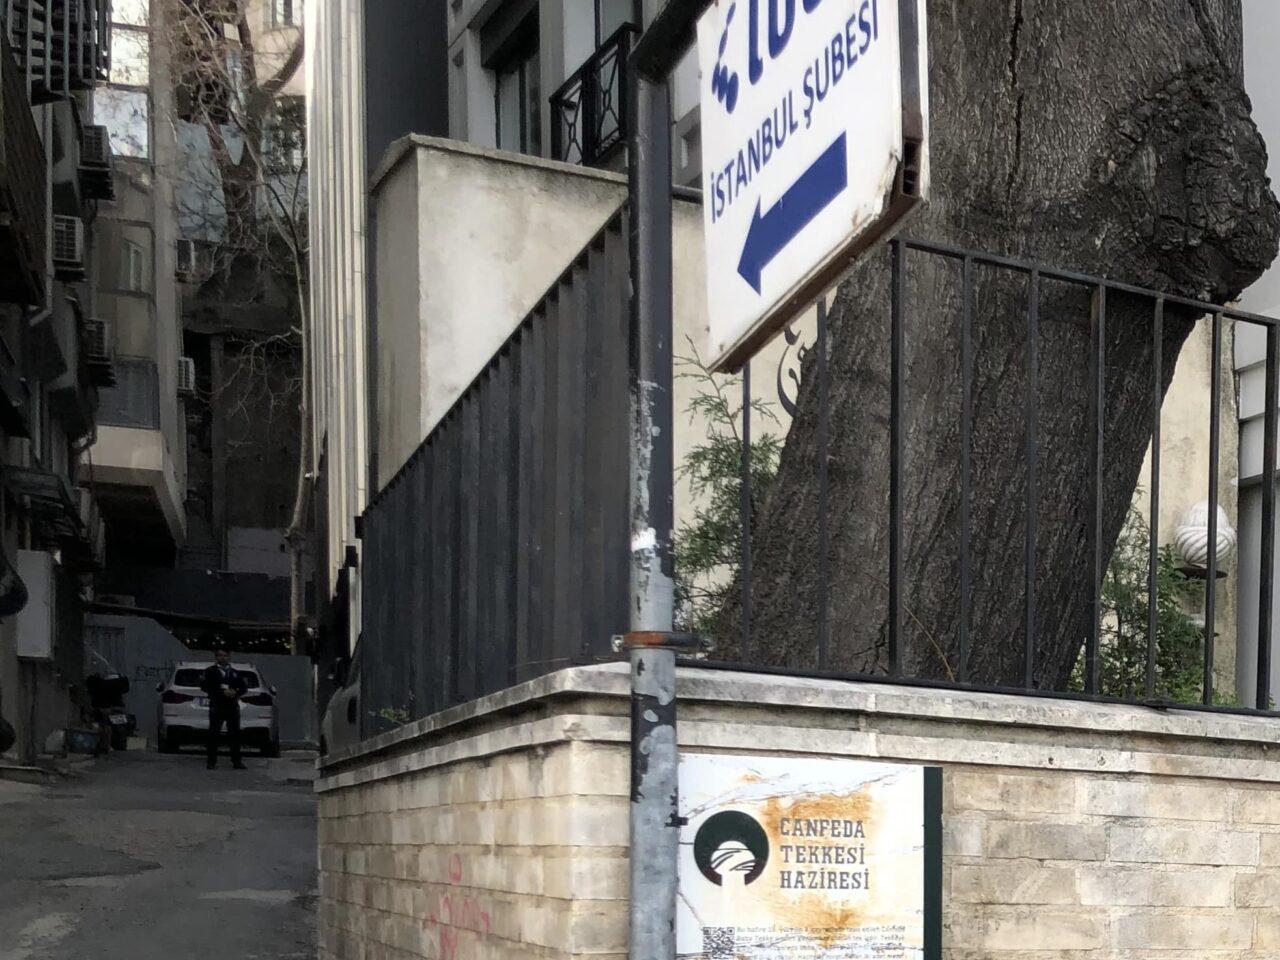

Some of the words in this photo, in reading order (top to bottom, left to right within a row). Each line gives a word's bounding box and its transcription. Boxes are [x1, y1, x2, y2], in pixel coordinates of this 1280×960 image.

[711, 90, 799, 224] İSTANBUL
[780, 817, 866, 838] CANFEDA
[780, 843, 866, 865] TEKKESİ
[780, 867, 870, 890] HAZİRESİ
